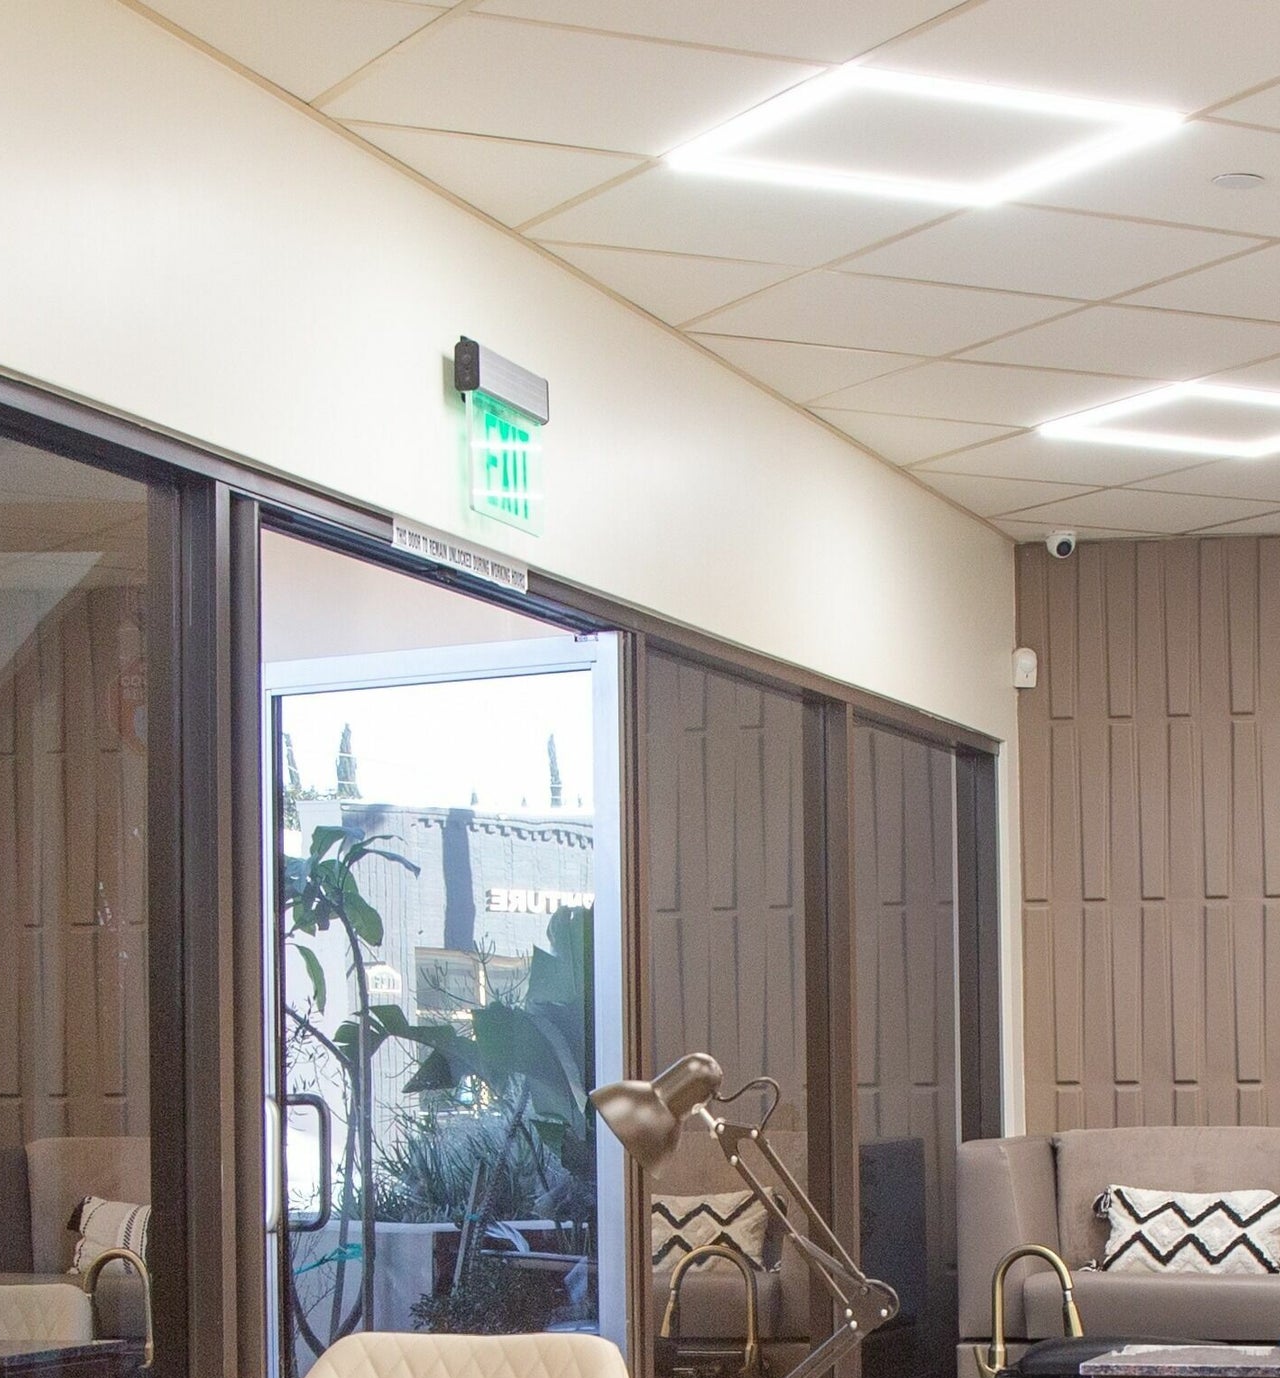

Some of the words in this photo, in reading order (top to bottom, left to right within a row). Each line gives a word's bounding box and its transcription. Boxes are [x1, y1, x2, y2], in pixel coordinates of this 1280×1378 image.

[484, 413, 530, 519] EXIT
[429, 539, 447, 561] REMAIN
[448, 546, 472, 569] UNLOCKED
